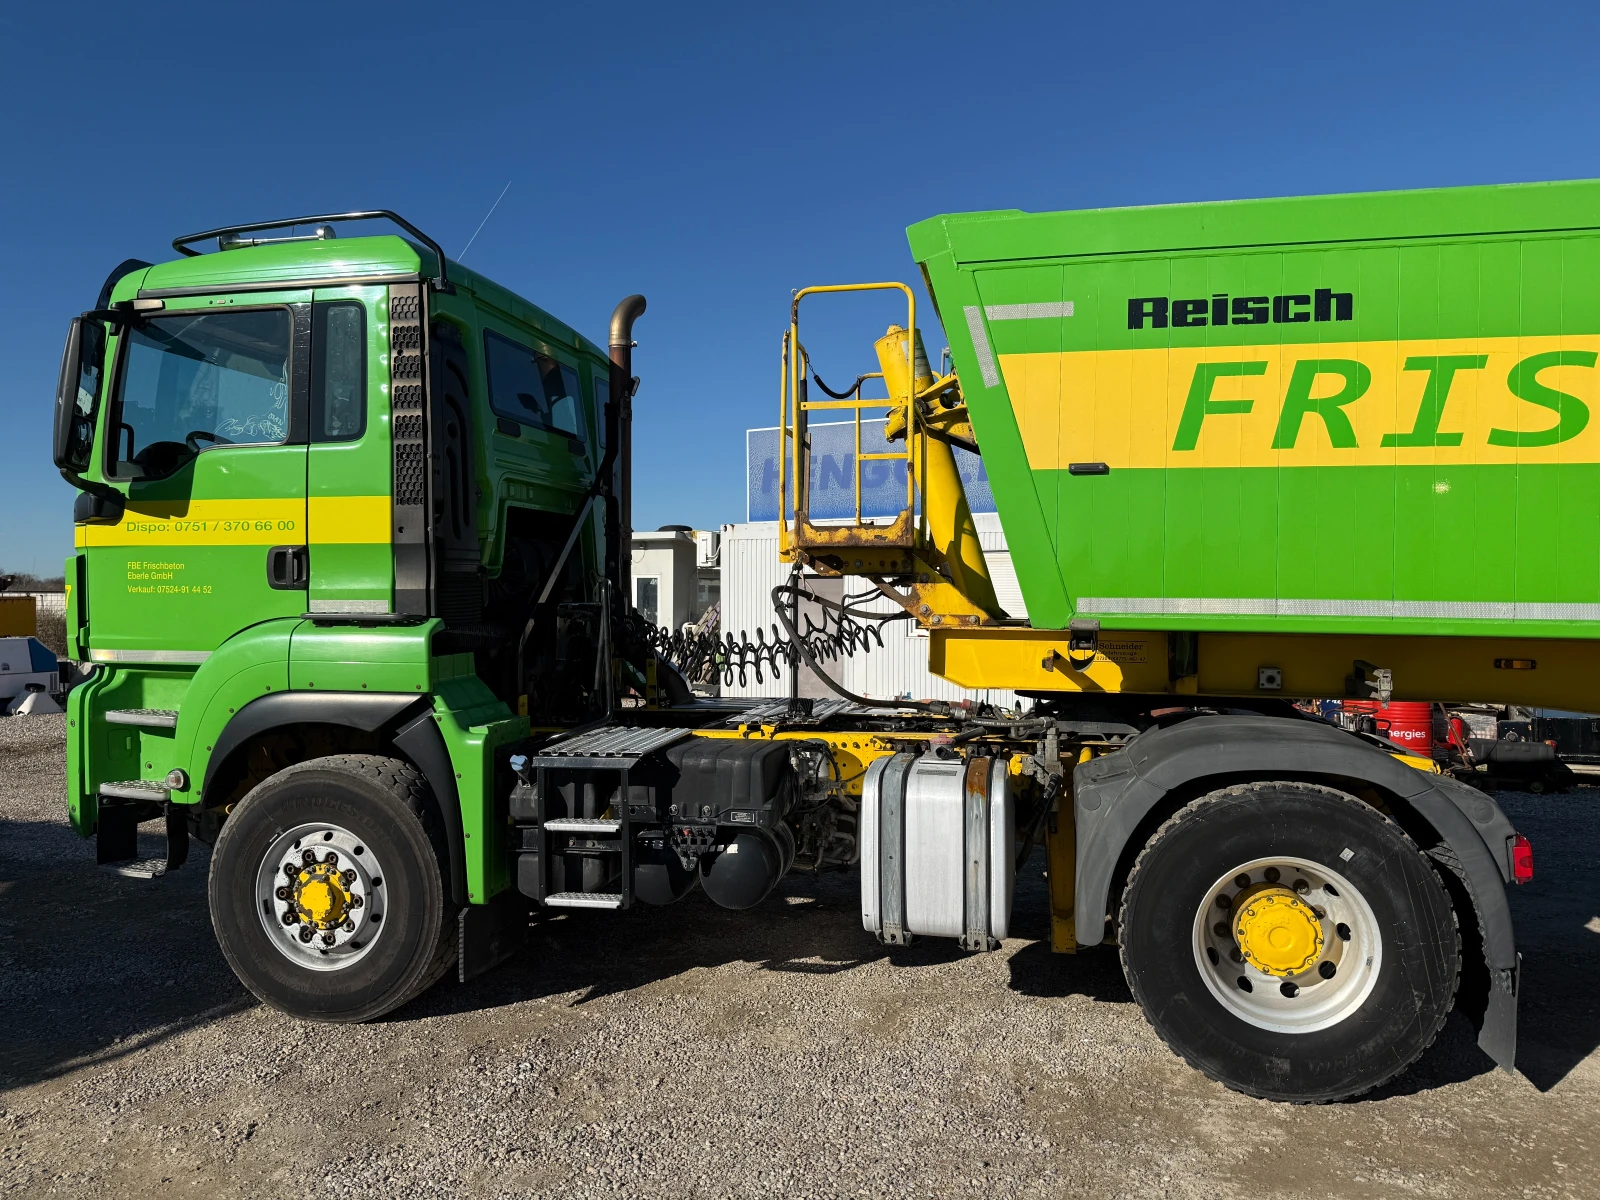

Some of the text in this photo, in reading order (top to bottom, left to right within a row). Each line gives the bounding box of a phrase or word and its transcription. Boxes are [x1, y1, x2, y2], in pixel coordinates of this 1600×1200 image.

[1128, 288, 1353, 329] Reisch
[1171, 350, 1599, 451] FRIS
[126, 520, 295, 534] Dispo: 0751 / 370 66 00
[127, 561, 185, 570] FBE Frischbeton
[127, 571, 173, 580] Eberle GmbH
[127, 584, 212, 594] Verkauf: 07524-91 44 52
[1099, 642, 1144, 651] Schneider
